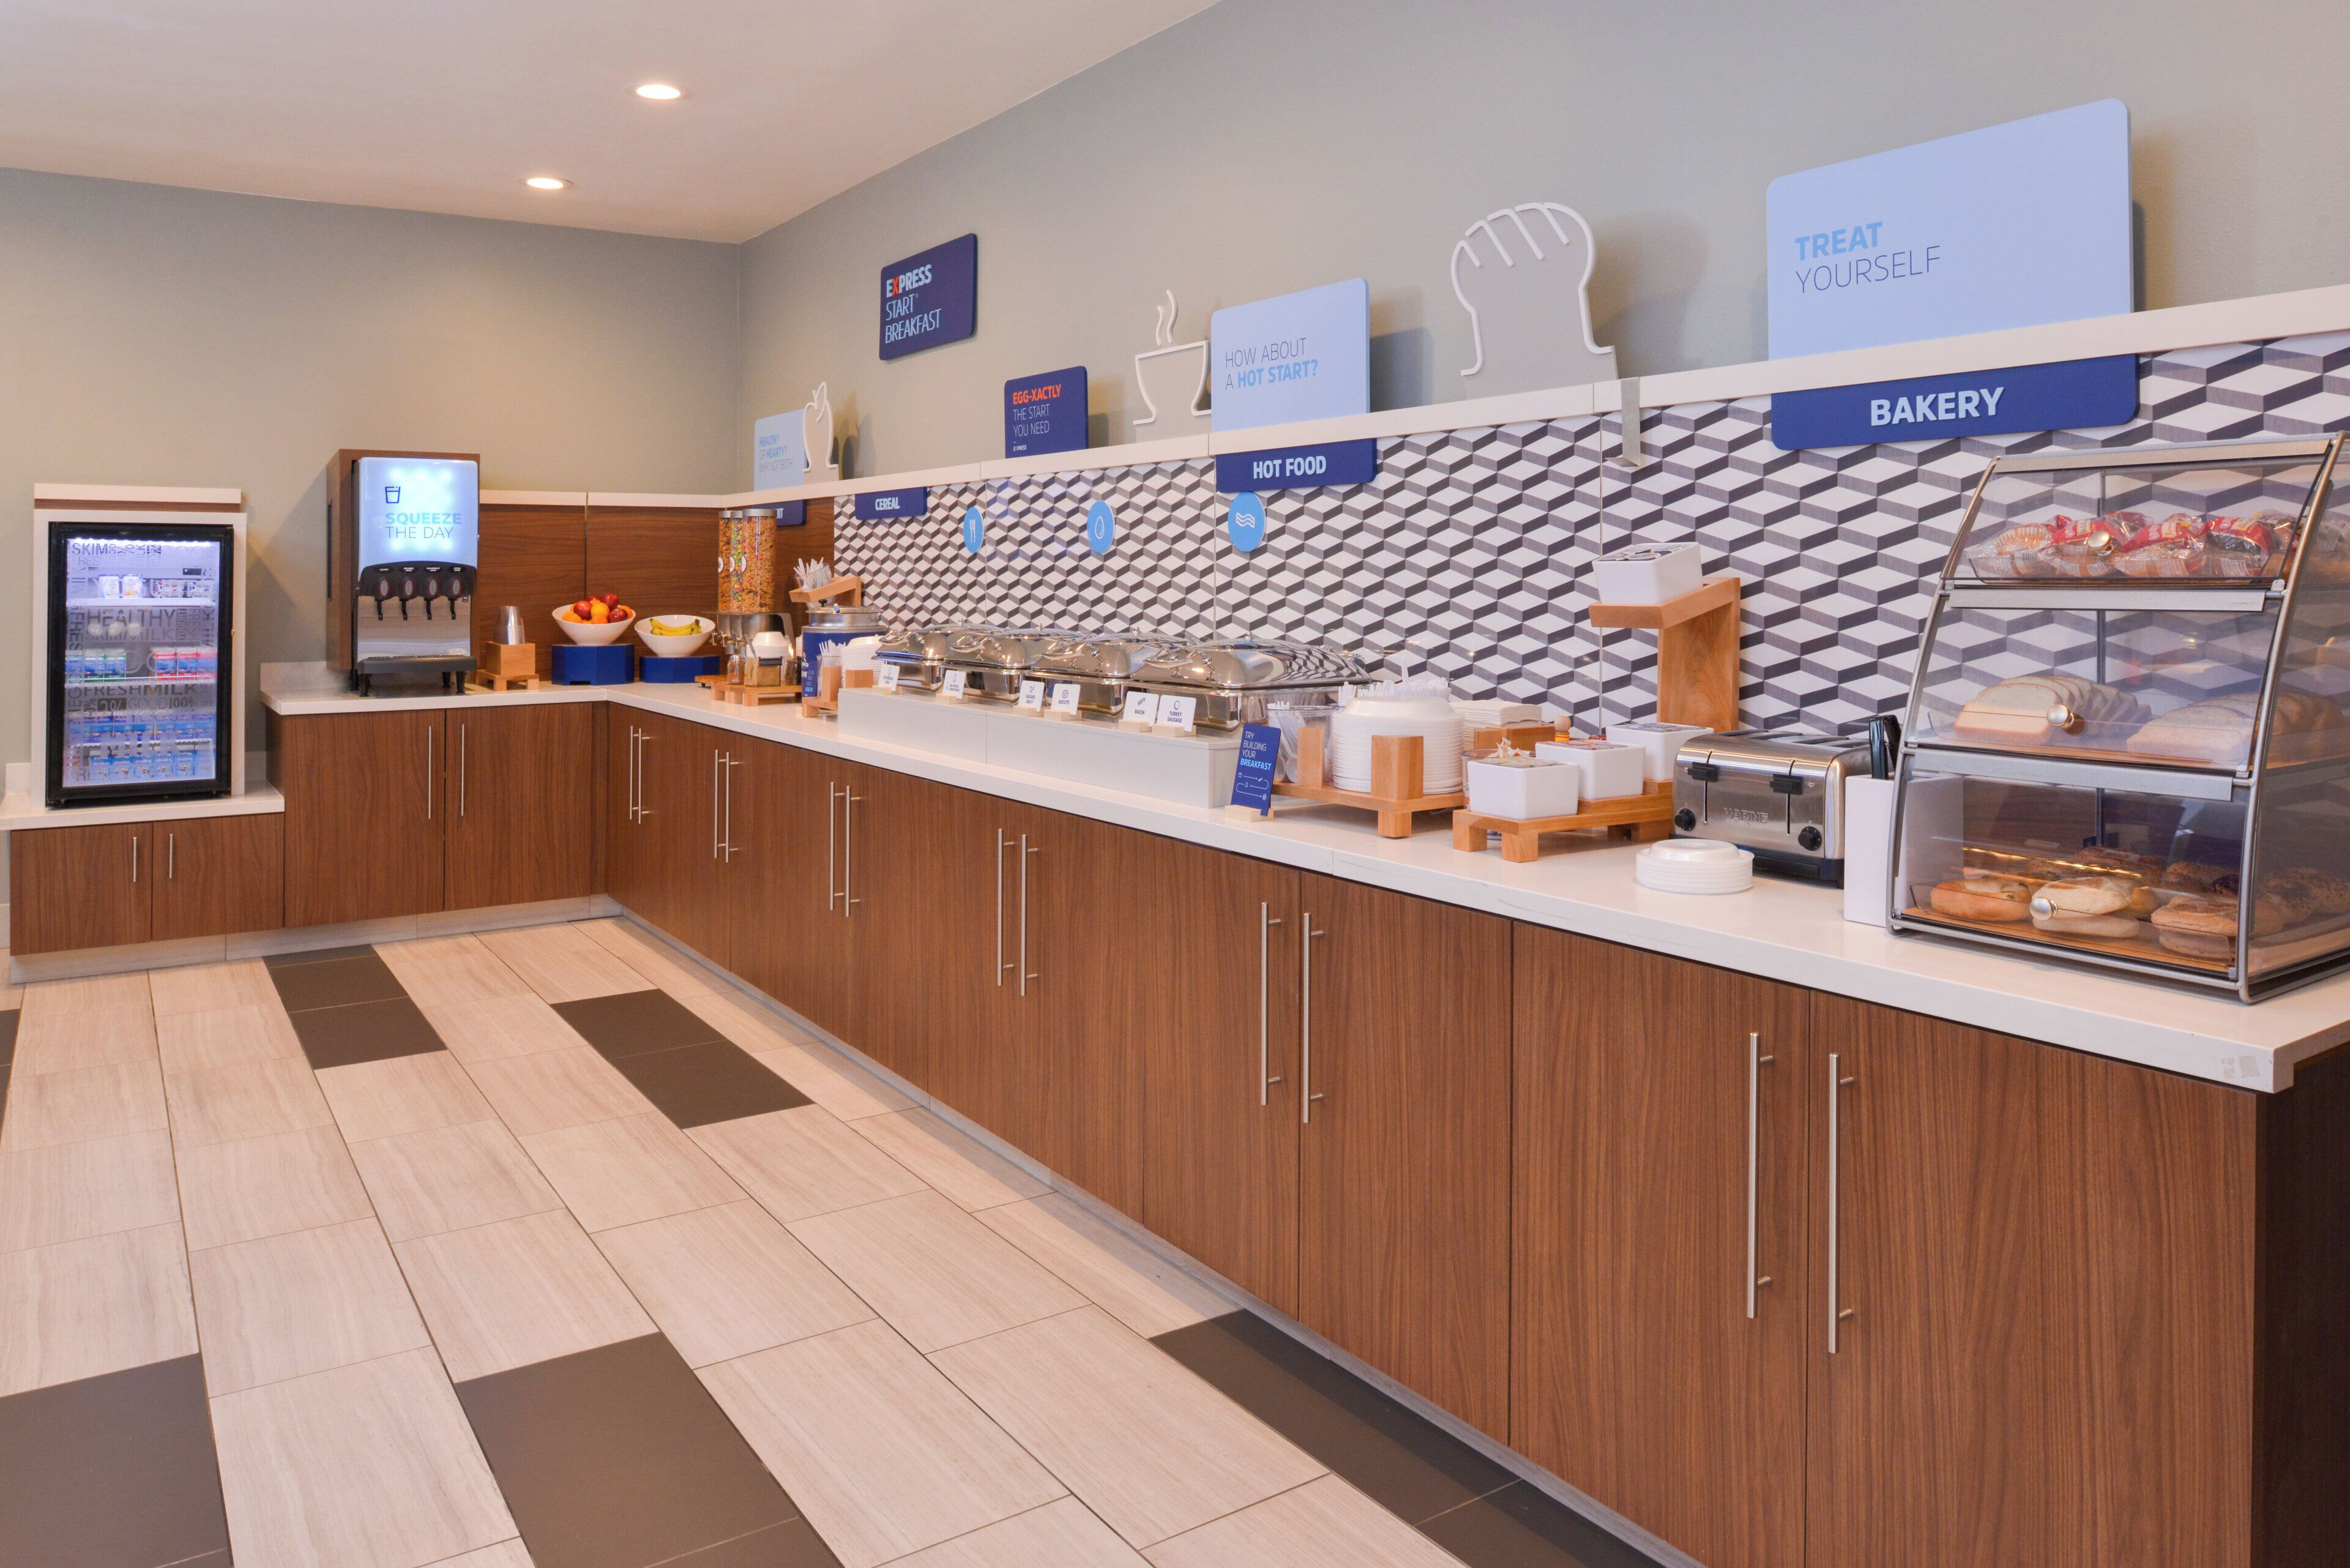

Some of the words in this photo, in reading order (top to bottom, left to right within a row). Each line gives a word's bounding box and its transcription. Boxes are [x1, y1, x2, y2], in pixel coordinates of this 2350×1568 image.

[1794, 222, 1883, 261] TREAT
[1795, 245, 1941, 293] YOURSELF
[886, 264, 932, 298] EXPRESS
[885, 308, 942, 344] BREAKFAST
[1225, 347, 1256, 369] HOW
[1261, 337, 1307, 362] ABOUT
[1225, 373, 1234, 390] A
[1237, 368, 1264, 388] HOT
[1268, 359, 1318, 383] START?
[1013, 384, 1062, 405] EGG-XACTLY
[1013, 408, 1027, 421] THE
[1028, 403, 1050, 419] START
[1870, 386, 2005, 427] BAKERY
[1013, 424, 1028, 437] YOU
[1031, 420, 1050, 435] NEED
[1253, 459, 1282, 479] HOT
[1286, 455, 1327, 477] FOOD
[875, 497, 900, 511] CEREAL
[385, 512, 461, 525] SQUEEZE
[385, 526, 417, 539] THE
[423, 526, 454, 539] DAY
[72, 543, 108, 555] SKIM
[88, 609, 177, 627] HEALTHY
[1245, 731, 1255, 739] TRY
[1242, 749, 1256, 758] YOUR
[1243, 740, 1267, 752] BUILDING
[1240, 758, 1272, 771] BREAKFAST
[1723, 807, 1769, 824] WARING
